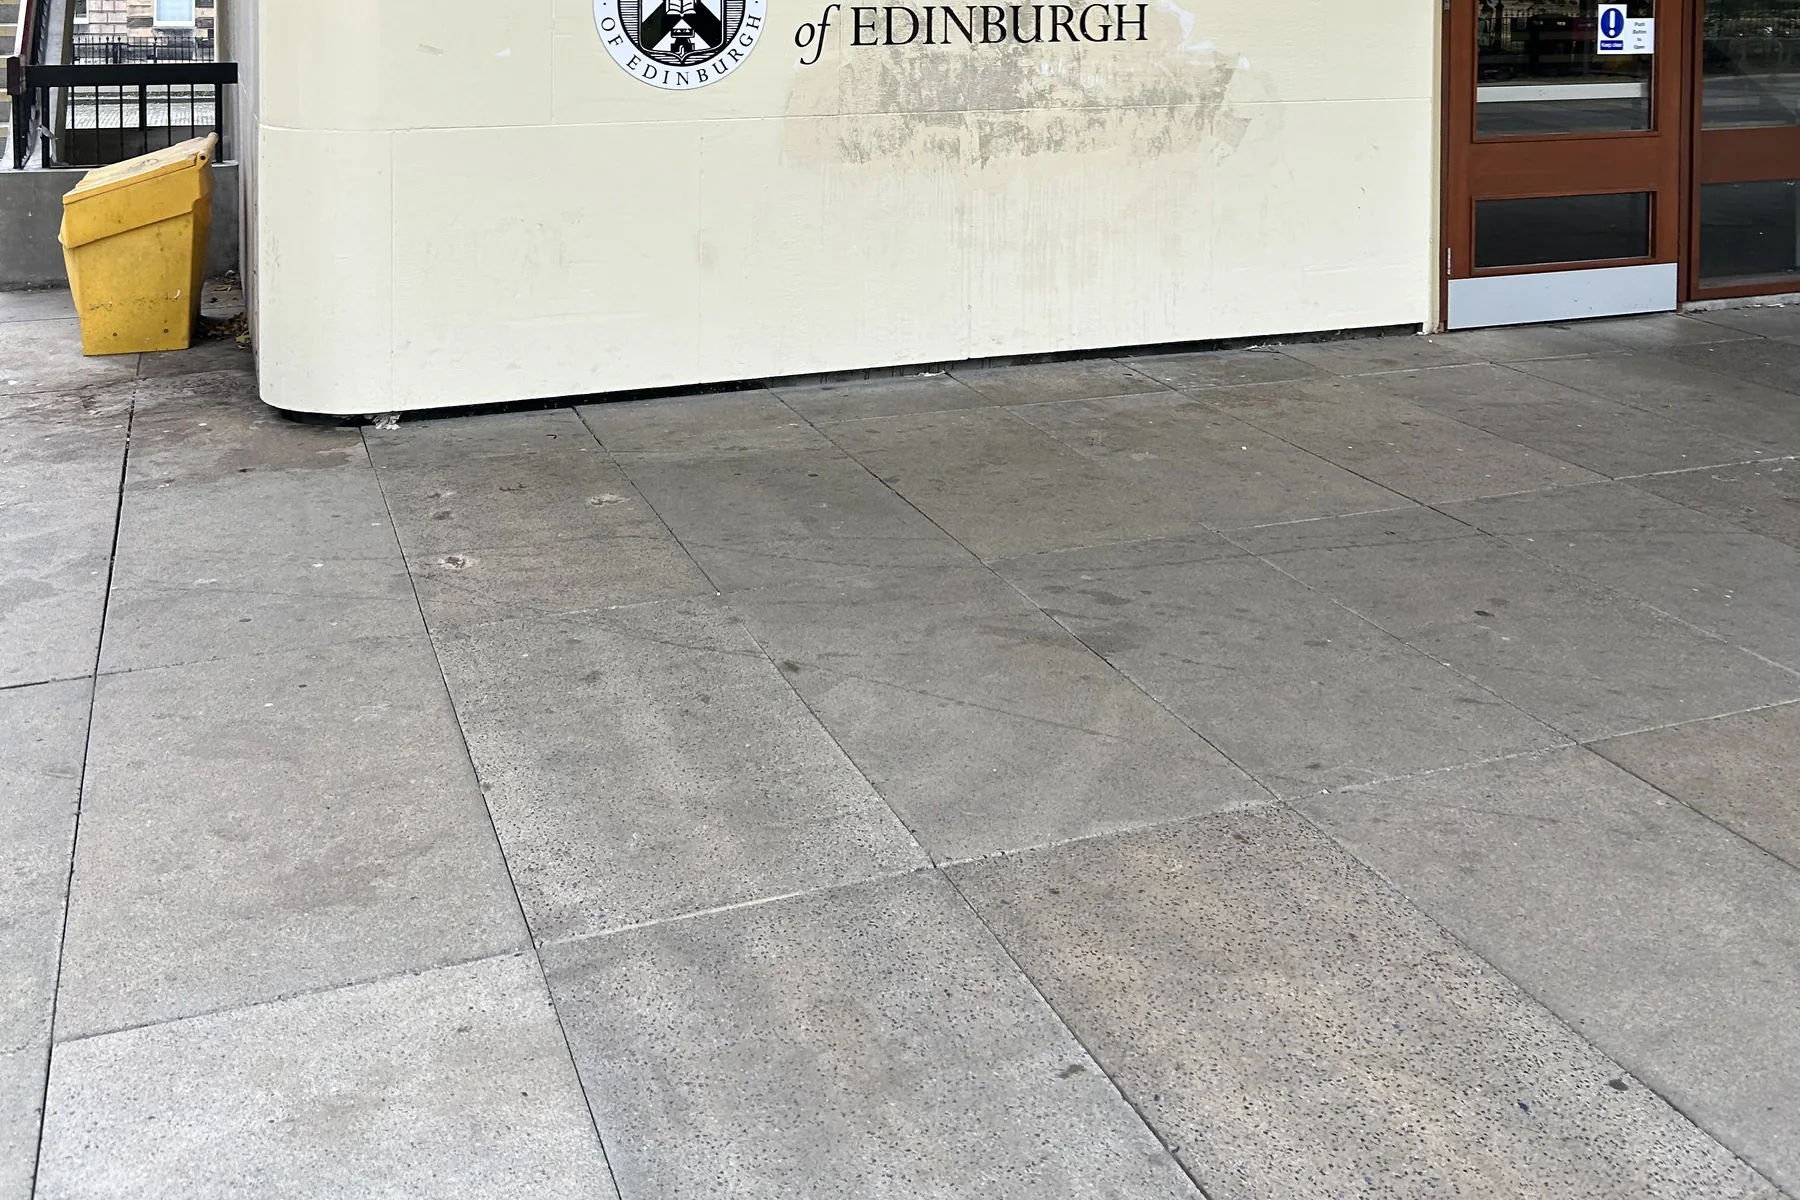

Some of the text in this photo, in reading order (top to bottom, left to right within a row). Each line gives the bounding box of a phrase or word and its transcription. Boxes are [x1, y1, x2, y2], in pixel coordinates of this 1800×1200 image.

[600, 15, 762, 86] OF EDINBURGH
[794, 3, 1149, 65] of EDINBURGH
